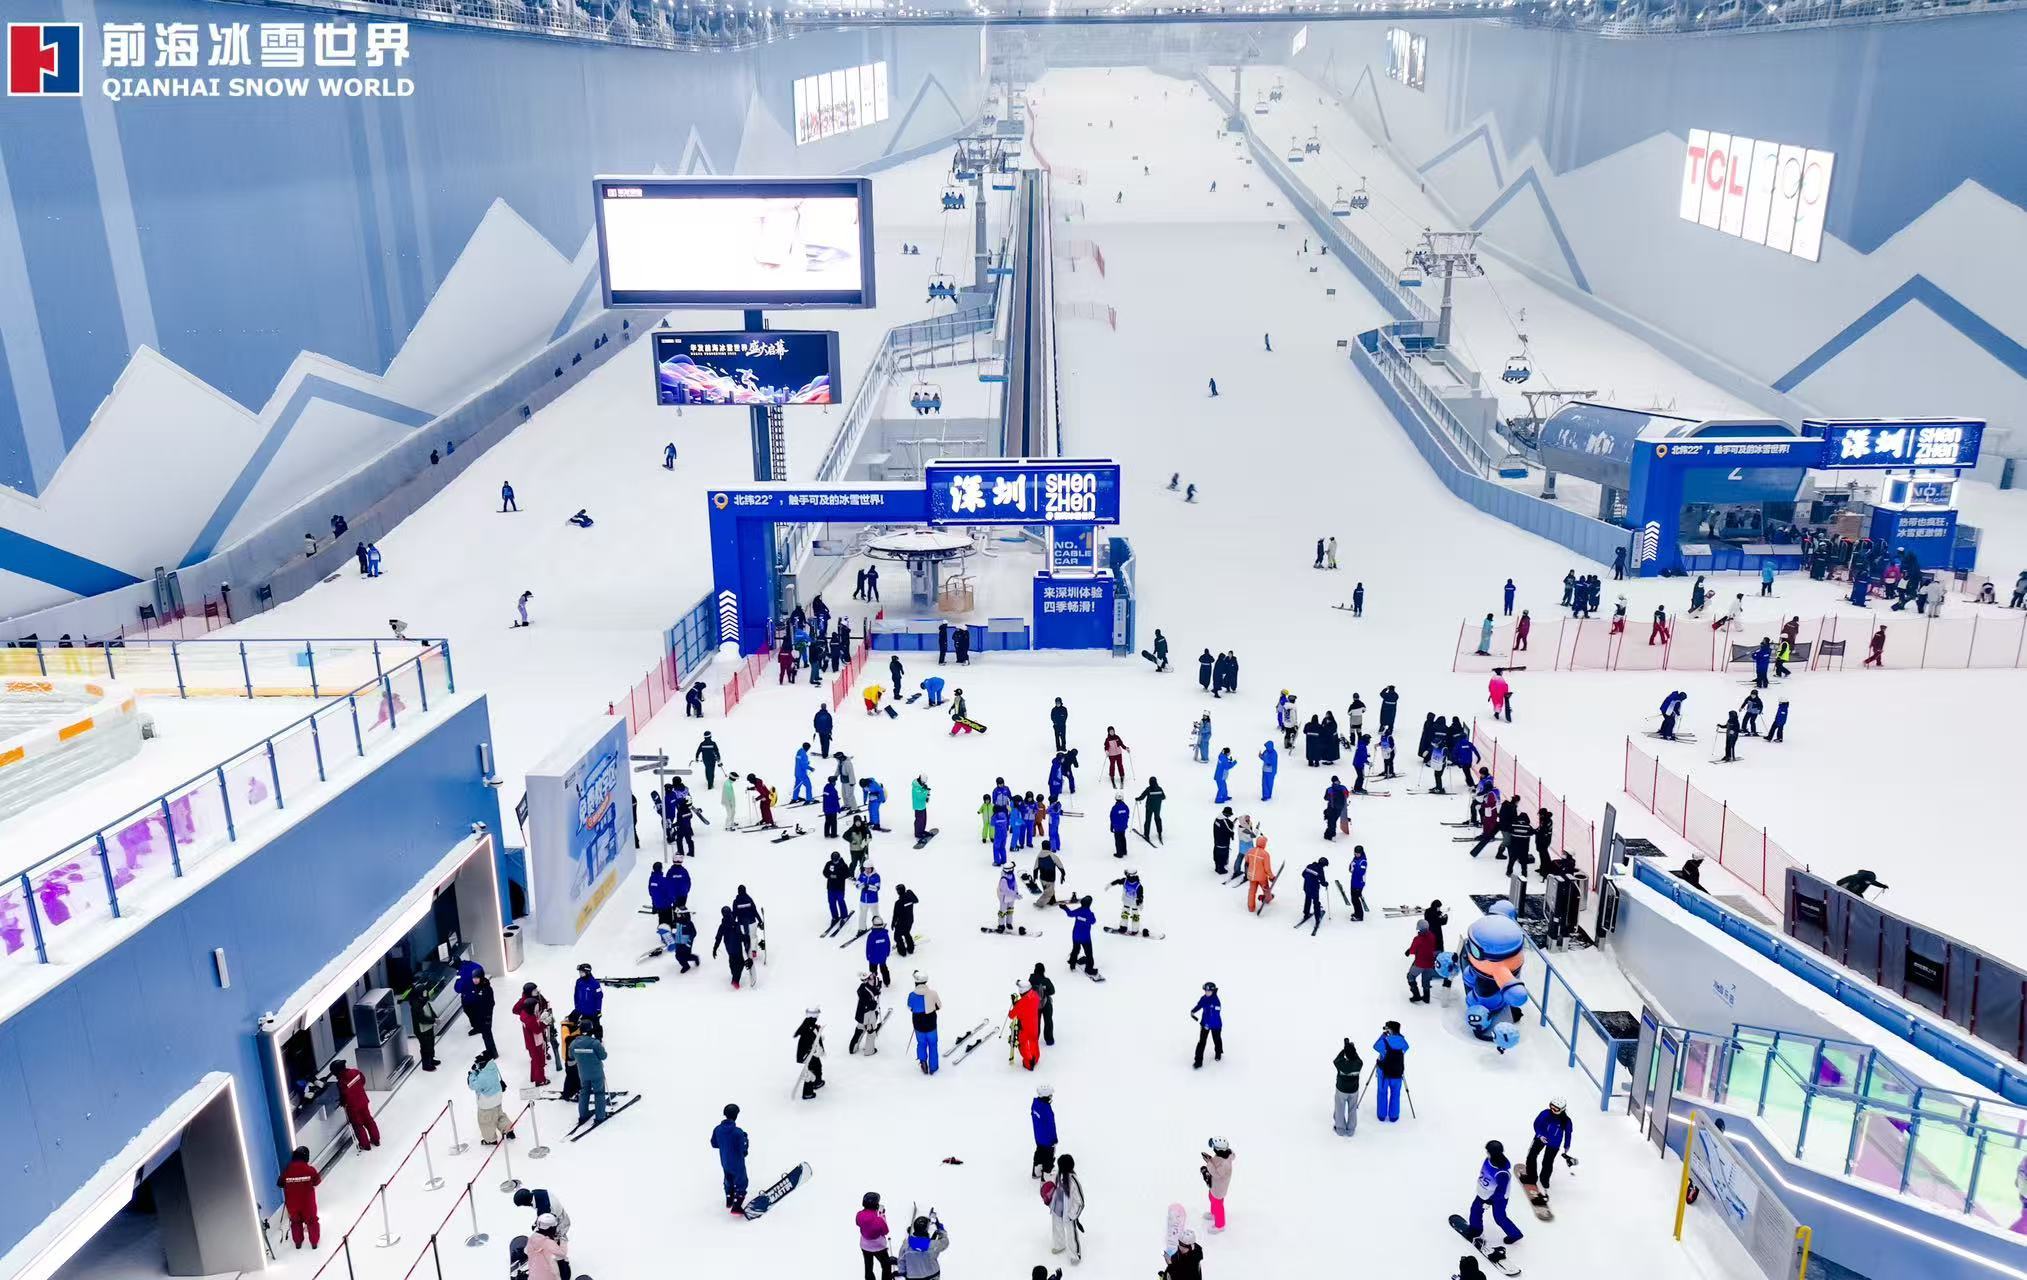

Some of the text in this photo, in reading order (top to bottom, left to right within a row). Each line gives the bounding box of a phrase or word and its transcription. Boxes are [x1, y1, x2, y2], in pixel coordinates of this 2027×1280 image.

[1688, 146, 1744, 197] TCL
[950, 473, 1026, 513] 深圳
[1043, 586, 1103, 599] 来深圳体验
